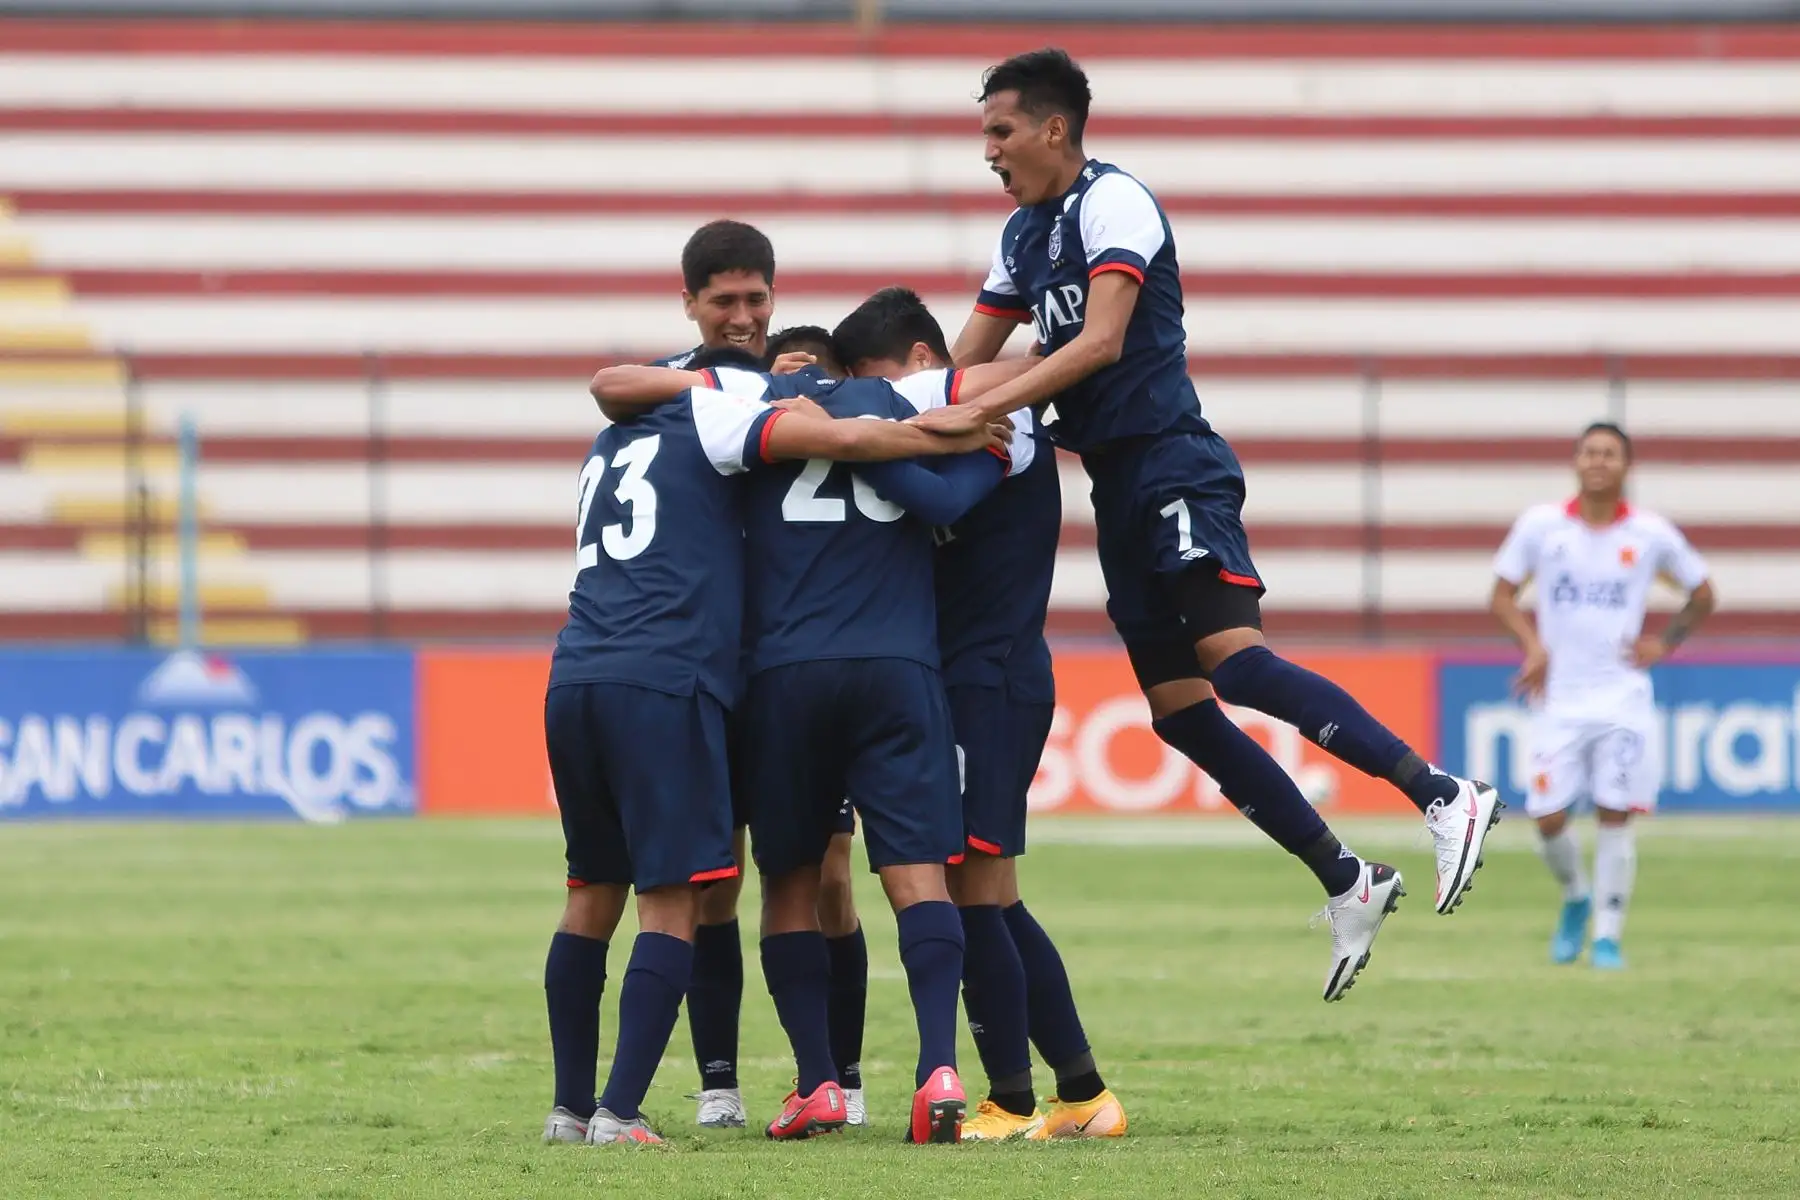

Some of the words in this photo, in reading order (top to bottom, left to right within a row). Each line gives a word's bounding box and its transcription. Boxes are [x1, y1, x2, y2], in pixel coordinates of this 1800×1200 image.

[576, 433, 660, 571] 23
[782, 414, 905, 522] 2
[1160, 498, 1193, 552] 7
[114, 712, 398, 820] CARLOS
